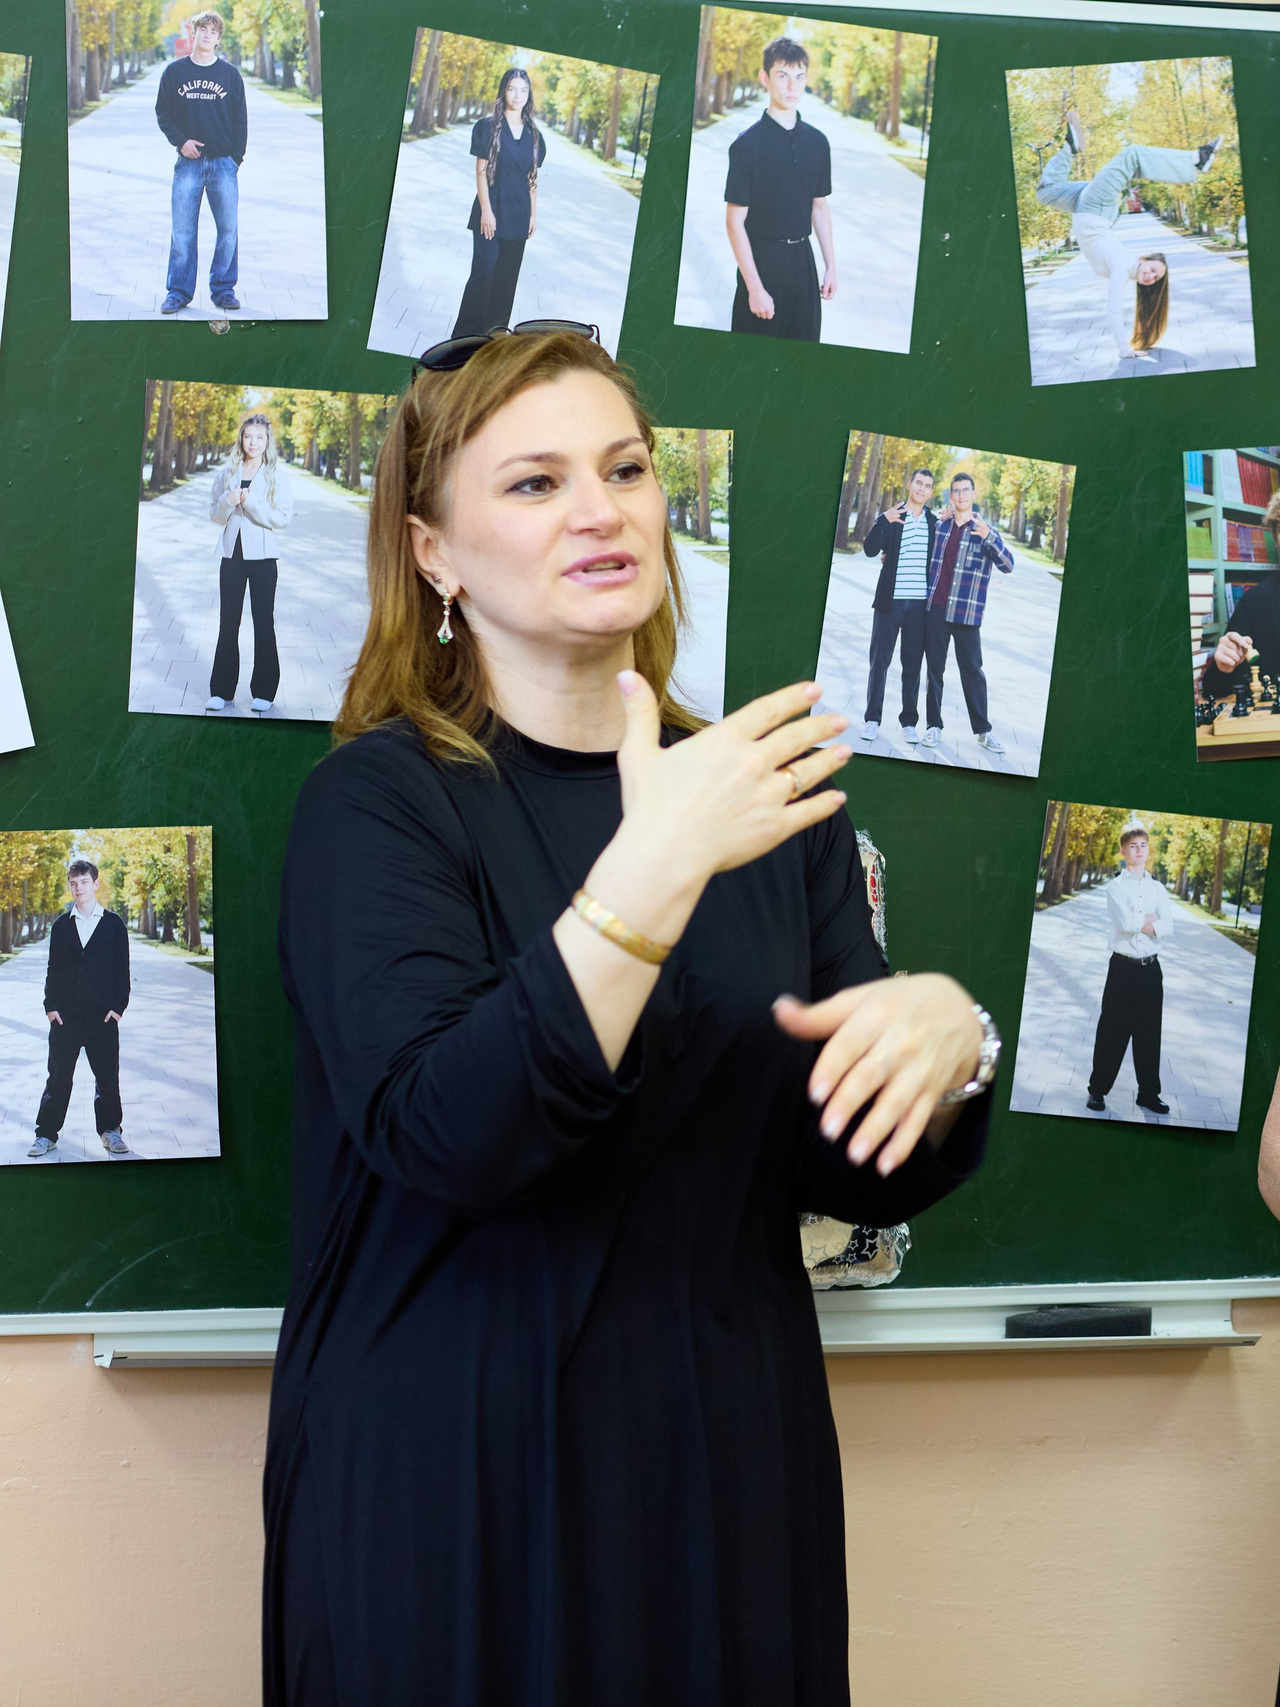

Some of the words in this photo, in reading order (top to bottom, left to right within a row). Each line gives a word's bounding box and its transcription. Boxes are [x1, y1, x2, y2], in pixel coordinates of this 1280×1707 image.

[177, 80, 227, 100] CALIFORNIA
[186, 92, 200, 100] WEST
[200, 93, 217, 101] COAST
